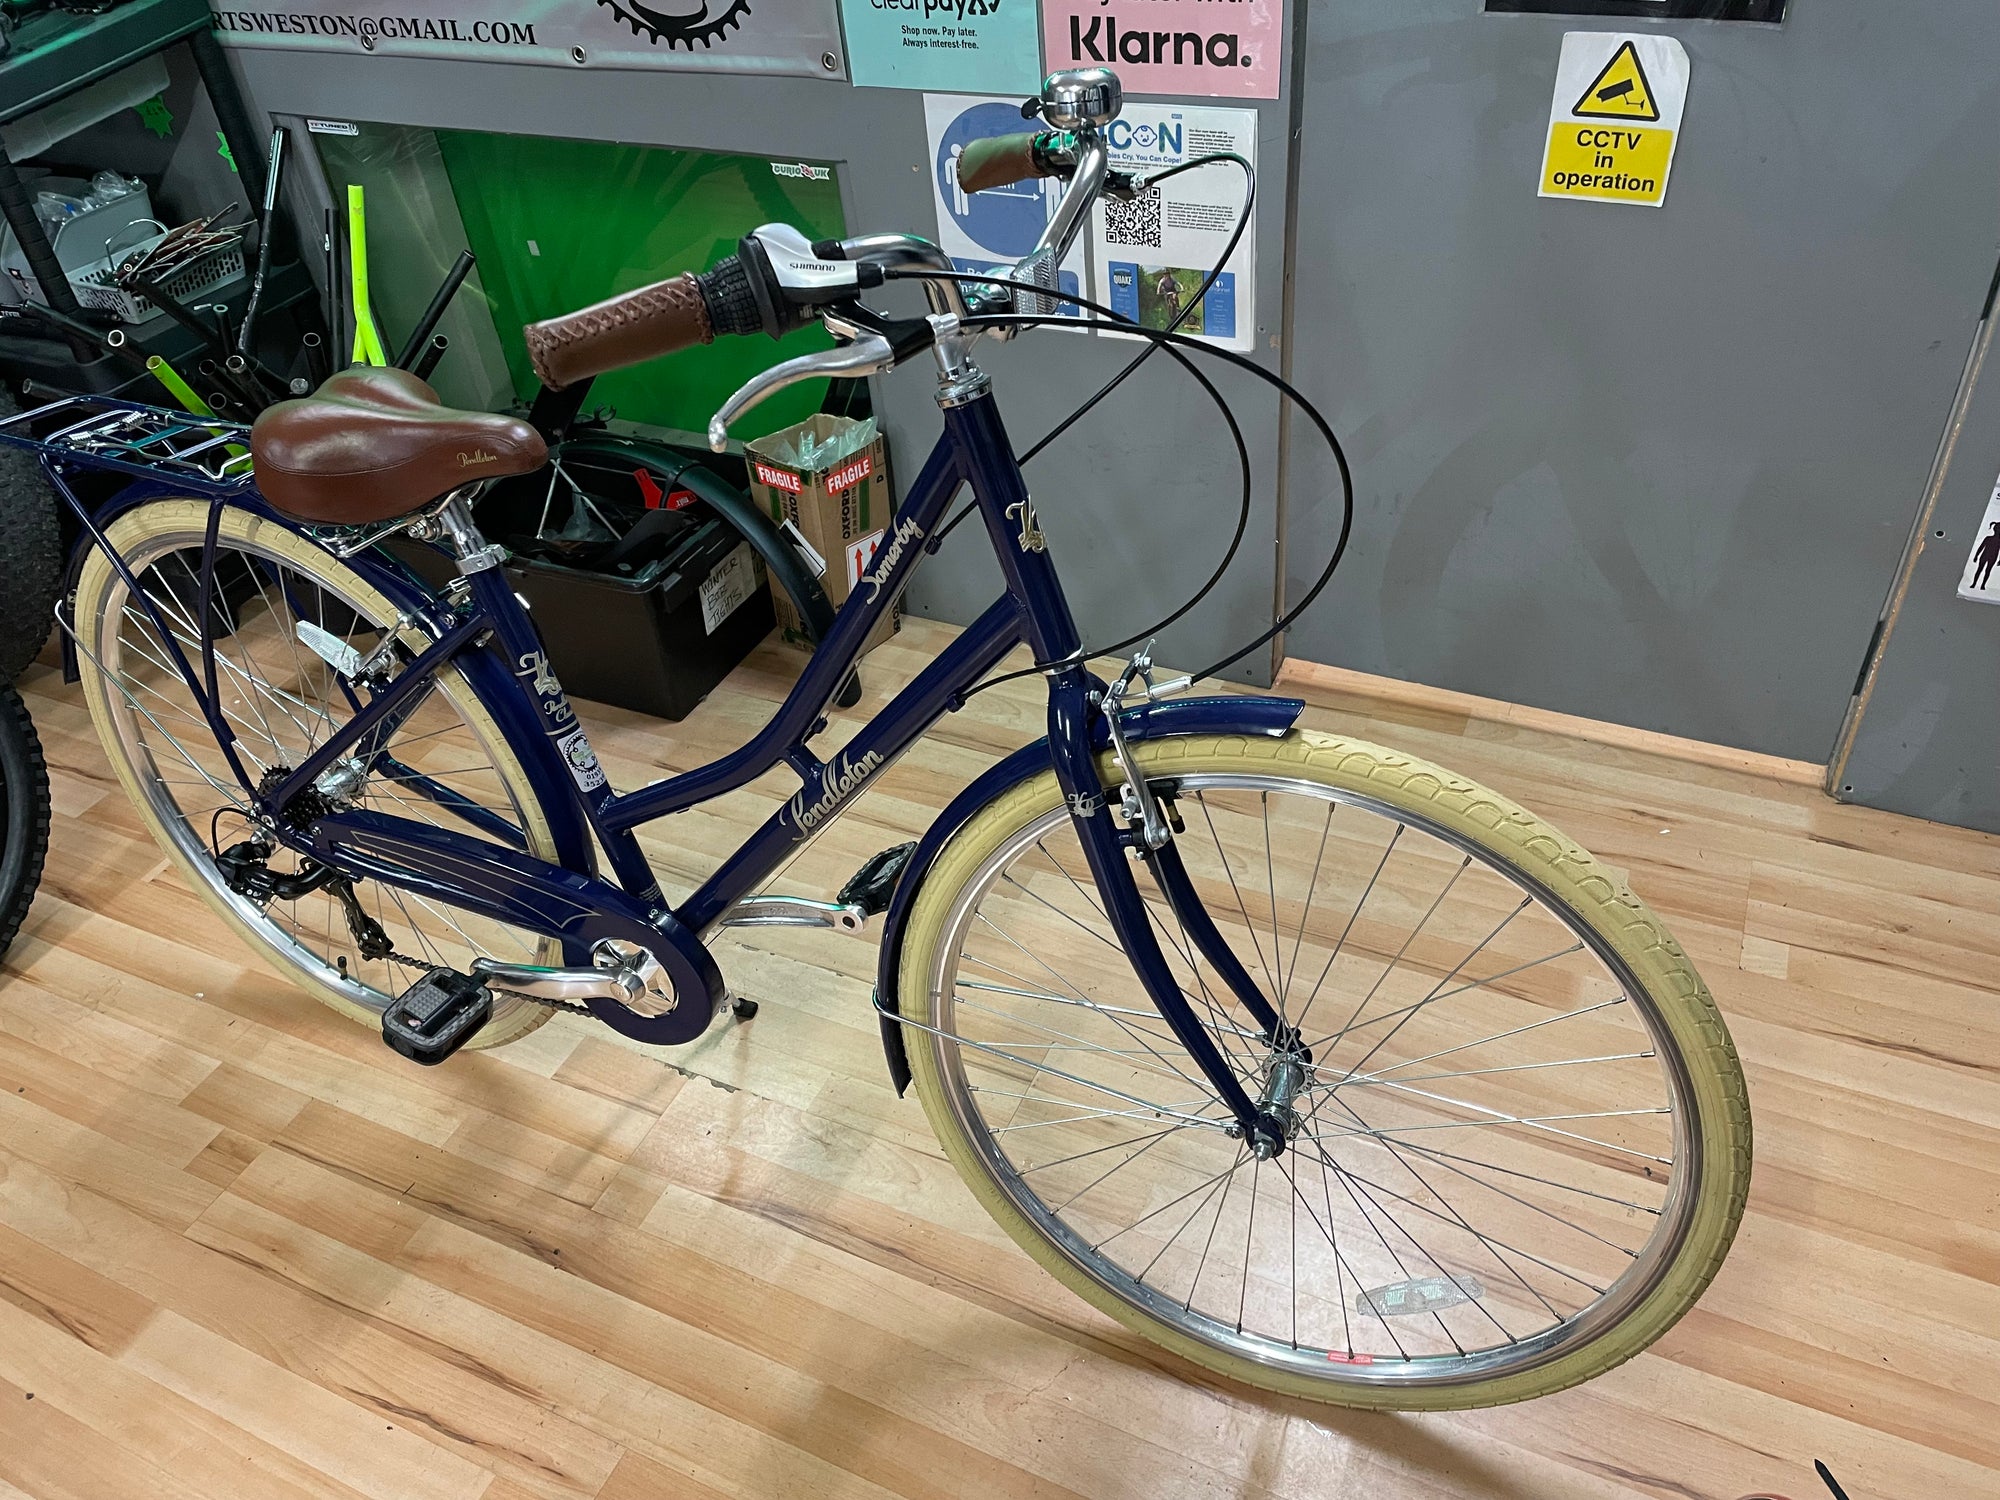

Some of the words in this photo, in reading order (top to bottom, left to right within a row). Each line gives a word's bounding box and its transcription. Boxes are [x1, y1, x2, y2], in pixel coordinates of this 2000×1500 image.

[901, 25, 920, 36] Shop
[922, 27, 940, 36] now.
[942, 27, 956, 37] Pay
[958, 27, 978, 37] later.
[1070, 15, 1252, 67] Klarna.
[902, 38, 928, 48] Always
[929, 39, 979, 49] interest-free.
[1576, 129, 1642, 150] CCTV
[1594, 151, 1614, 168] in
[773, 164, 801, 175] CURIO
[814, 168, 827, 177] UK
[1553, 171, 1655, 192] operation
[789, 262, 836, 272] SHIMANO
[456, 448, 498, 468] Pendleton
[757, 465, 801, 491] FRAGILE
[827, 458, 870, 494] FRAGILE
[841, 489, 850, 540] OXFORD
[861, 514, 925, 605] Somerby
[701, 557, 738, 596] WINTER
[779, 750, 884, 841] Pendleton
